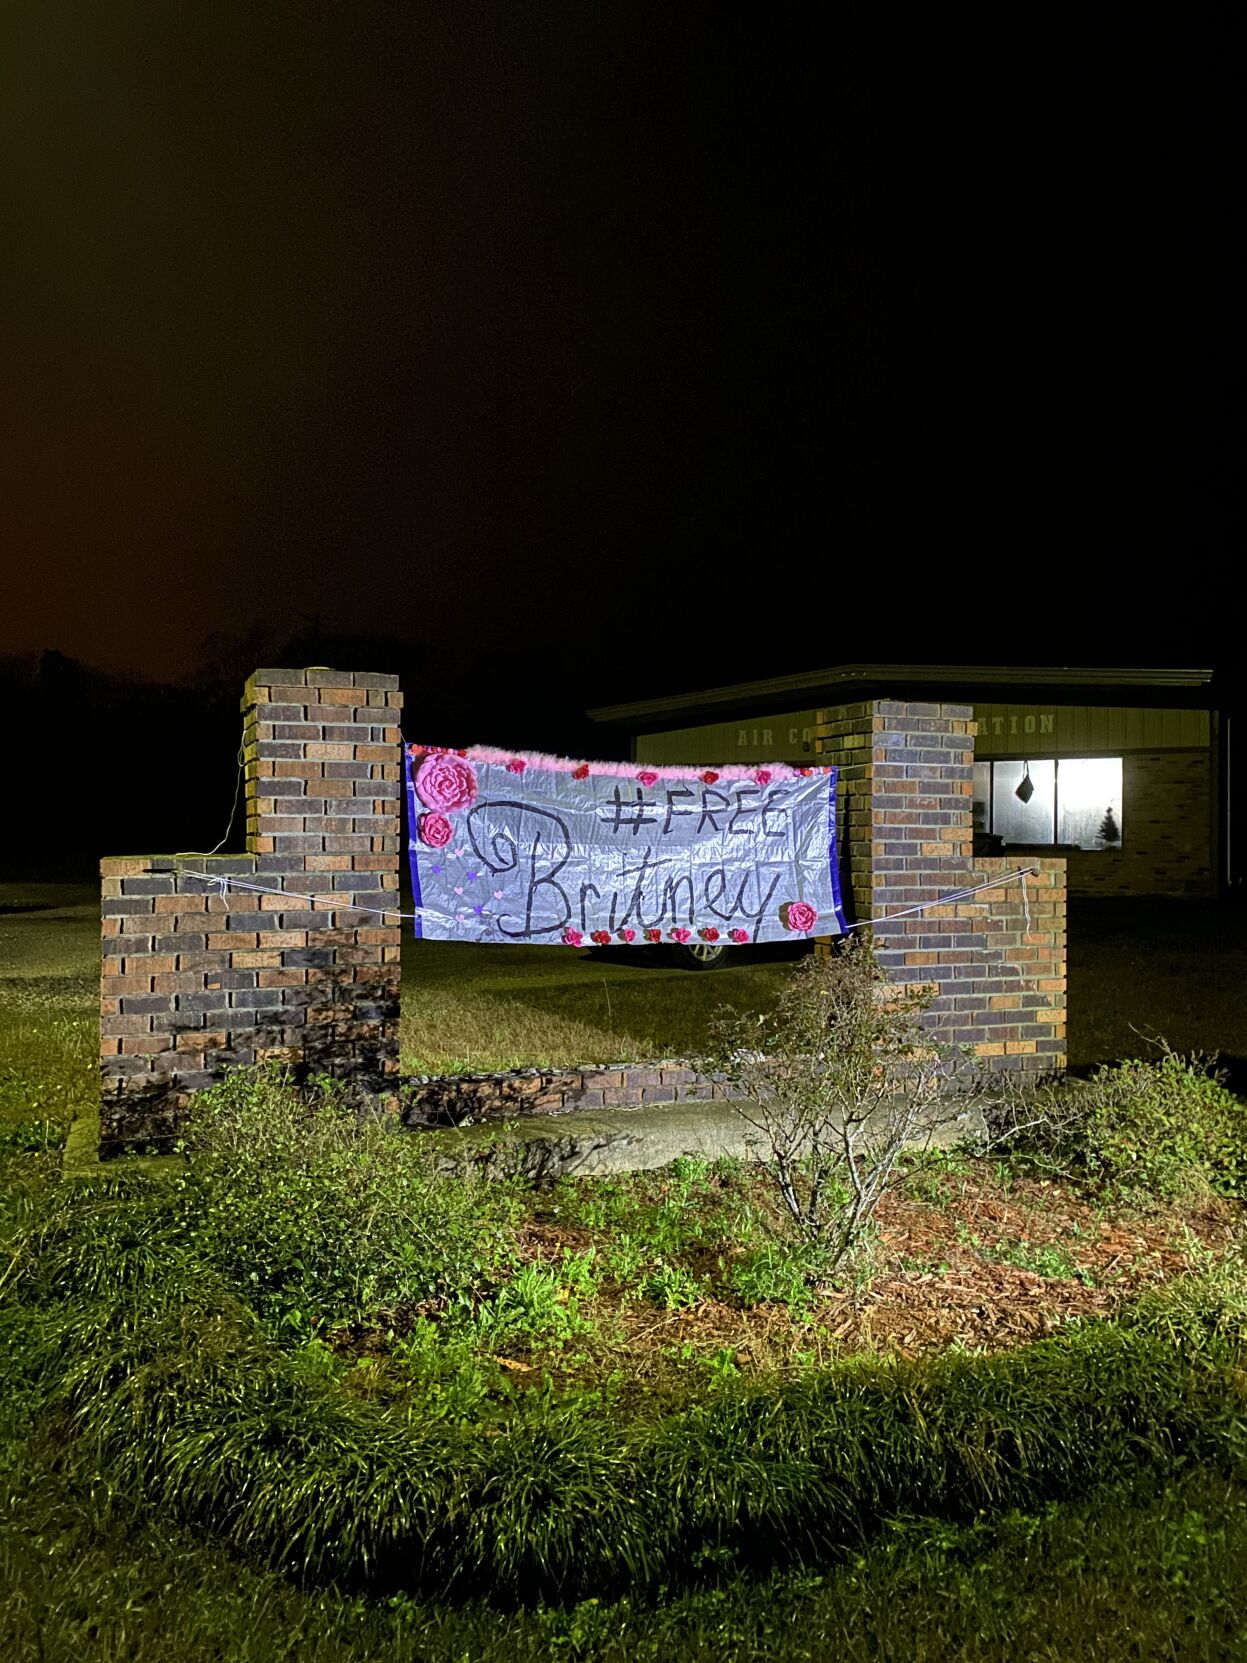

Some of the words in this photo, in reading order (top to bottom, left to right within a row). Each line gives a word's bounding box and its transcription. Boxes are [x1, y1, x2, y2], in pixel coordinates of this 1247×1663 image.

[737, 728, 774, 747] AIR
[600, 784, 791, 838] #FREE
[466, 800, 782, 943] Britney
